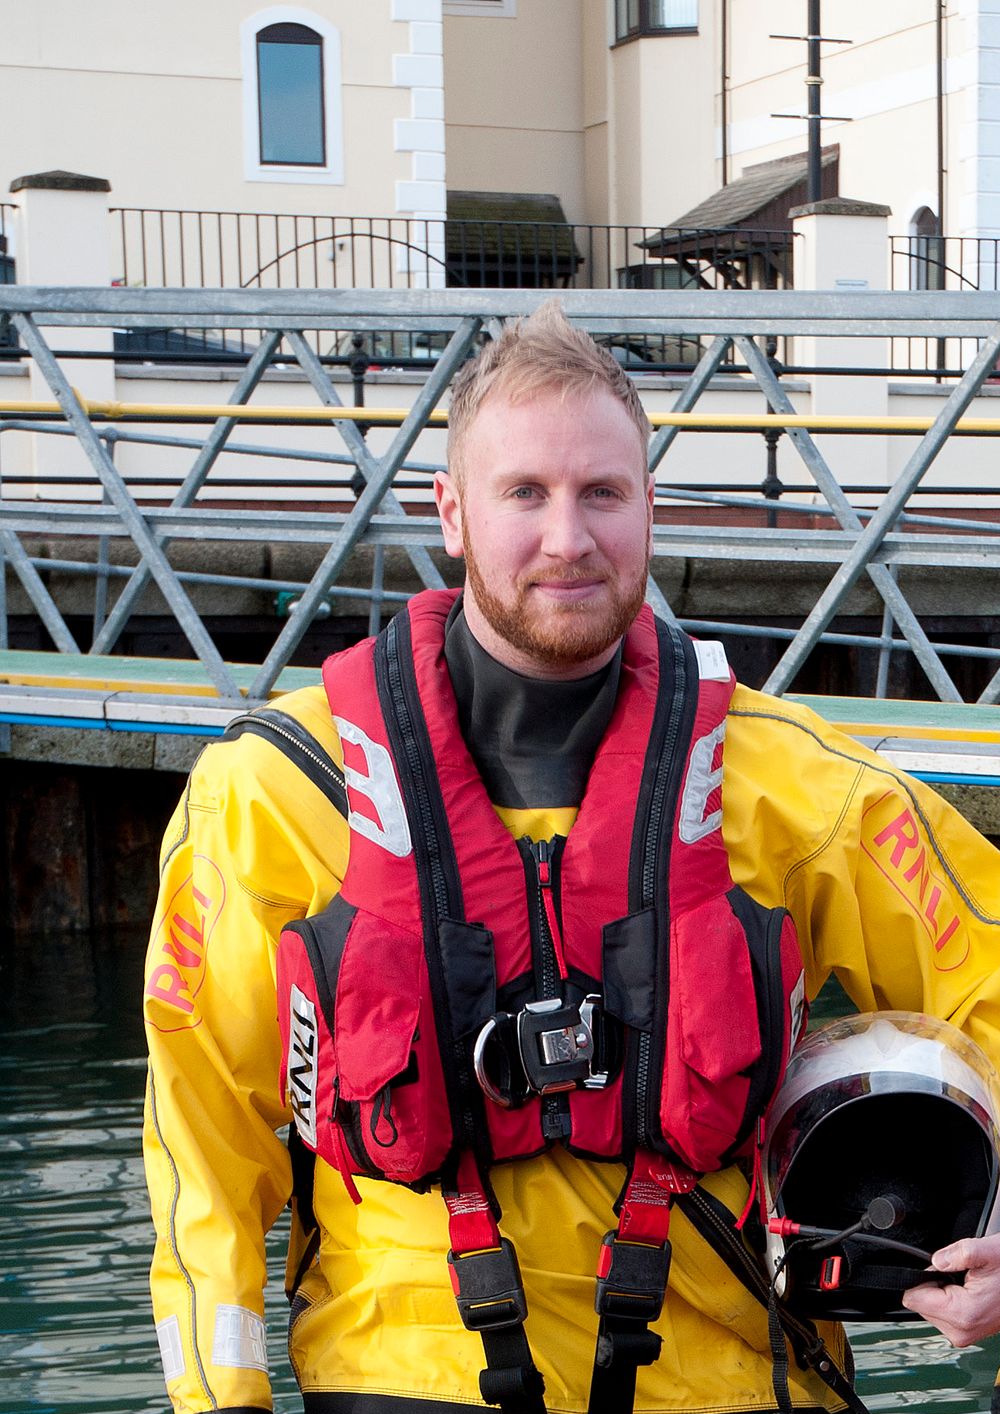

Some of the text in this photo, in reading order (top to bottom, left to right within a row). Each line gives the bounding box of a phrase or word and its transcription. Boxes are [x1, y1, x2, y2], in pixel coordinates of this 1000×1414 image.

[873, 808, 961, 952] RNLI
[146, 886, 212, 1013] RNLI
[289, 1007, 316, 1127] RNLI
